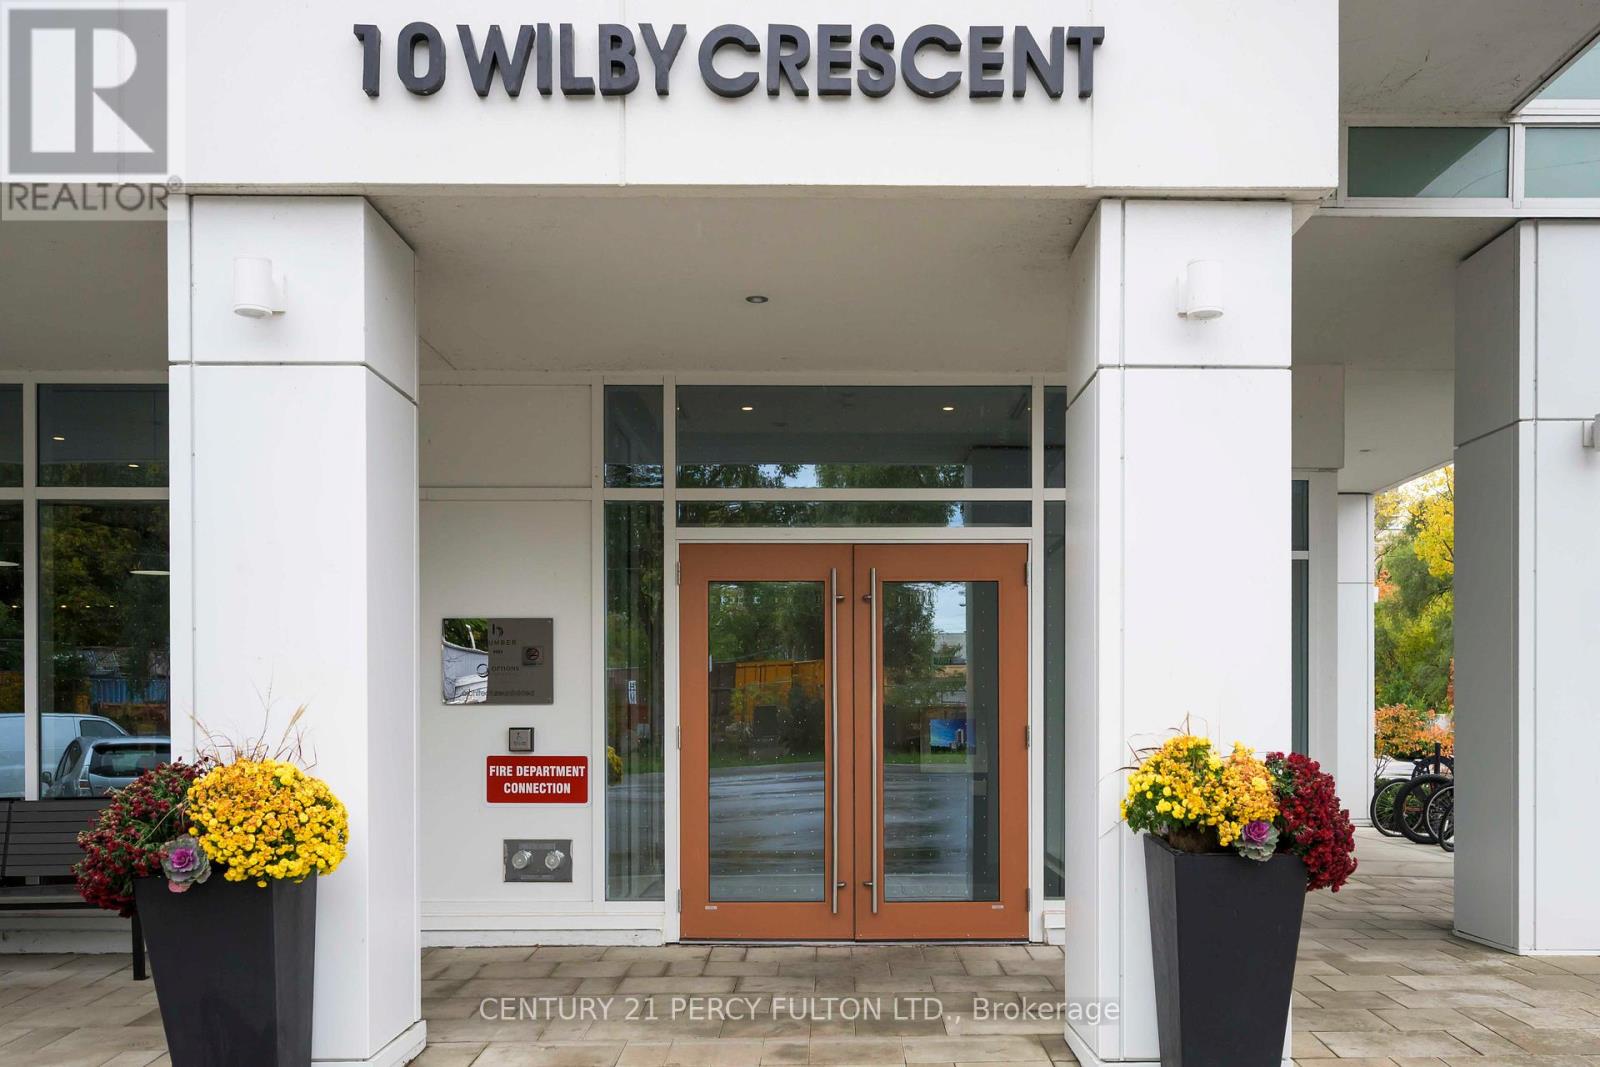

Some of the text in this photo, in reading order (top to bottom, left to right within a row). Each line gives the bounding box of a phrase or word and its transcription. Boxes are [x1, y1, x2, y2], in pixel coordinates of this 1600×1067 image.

[354, 22, 1105, 98] 10 WILBY CRESCENT
[489, 765, 586, 777] FIRE DEPARTMENT
[503, 782, 571, 794] CONNECTION
